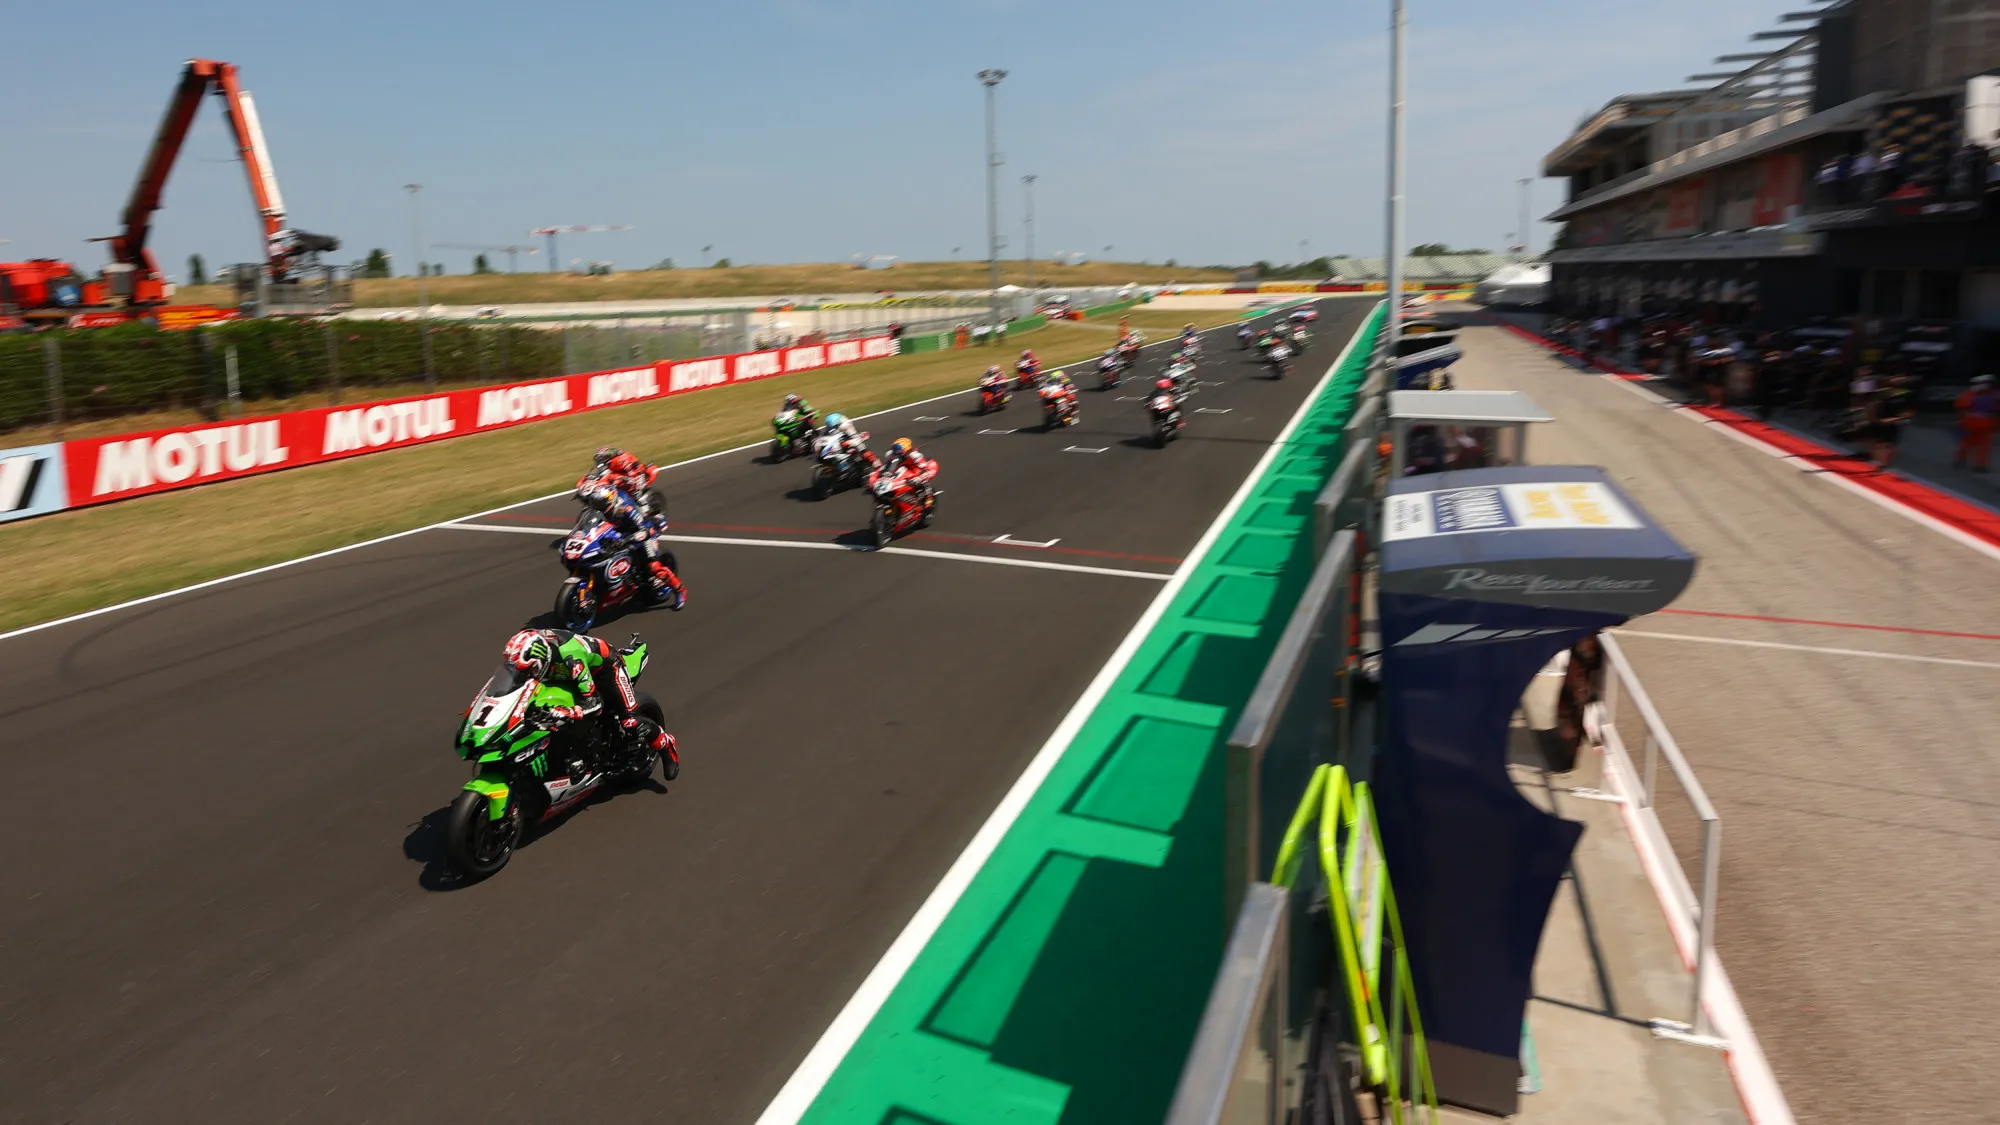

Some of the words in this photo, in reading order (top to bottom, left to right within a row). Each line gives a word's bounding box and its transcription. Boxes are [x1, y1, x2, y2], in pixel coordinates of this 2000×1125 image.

[669, 355, 728, 393] MOTUL
[733, 350, 782, 381] MOTUL
[476, 380, 573, 429] MOTUL
[586, 367, 660, 409] MOTUL
[322, 396, 455, 456] MOTUL
[92, 419, 289, 497] MOTUL
[566, 540, 584, 552] 54
[1443, 569, 1525, 591] Revs
[1523, 574, 1586, 595] Your
[1581, 576, 1656, 591] Heart
[474, 705, 494, 727] 1
